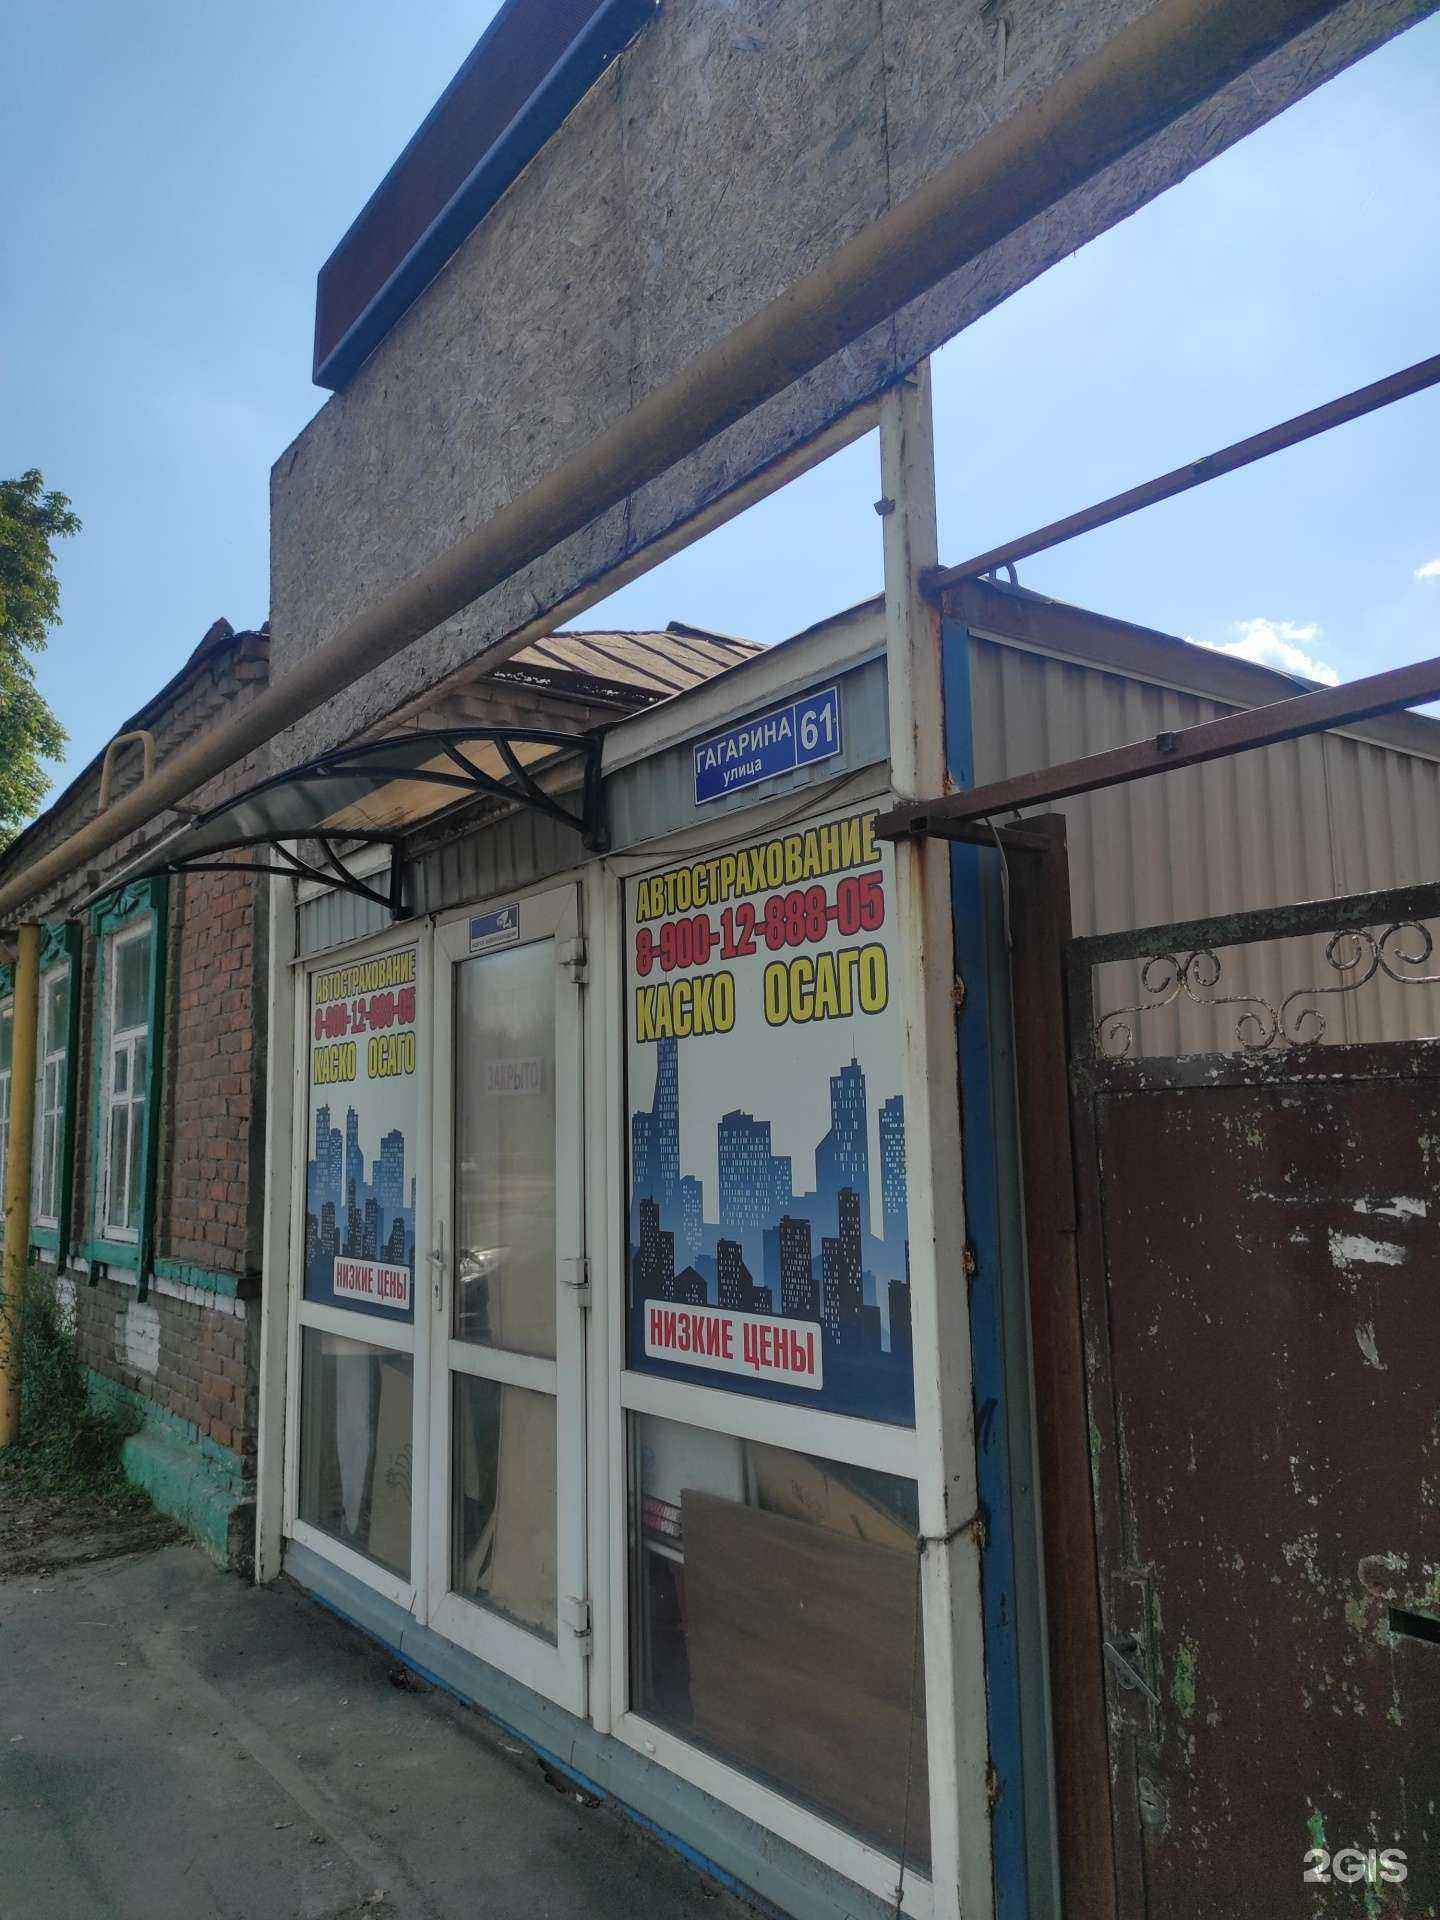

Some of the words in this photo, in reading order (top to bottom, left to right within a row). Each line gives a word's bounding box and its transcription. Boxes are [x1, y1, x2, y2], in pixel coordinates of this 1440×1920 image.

[696, 716, 792, 773] ГАГАРИНА
[800, 702, 833, 750] 61
[723, 759, 762, 787] улица
[635, 809, 882, 923] АВТОСТРАХОВАНИЕ
[635, 870, 885, 977] 8-900-12-888-05
[315, 948, 416, 1005] АВТОСТРАХОВАНИЕ
[635, 969, 736, 1043] КАСКО
[763, 942, 889, 1027] ОСАГО
[313, 1041, 357, 1085] КАСКО
[367, 1030, 416, 1079] ОСАГО
[336, 1262, 374, 1293] НИЗКИЕ
[377, 1268, 407, 1301] ЦЕНЫ
[650, 1308, 734, 1360] НИЗКИЕ
[743, 1322, 815, 1375] ЦЕНЫ
